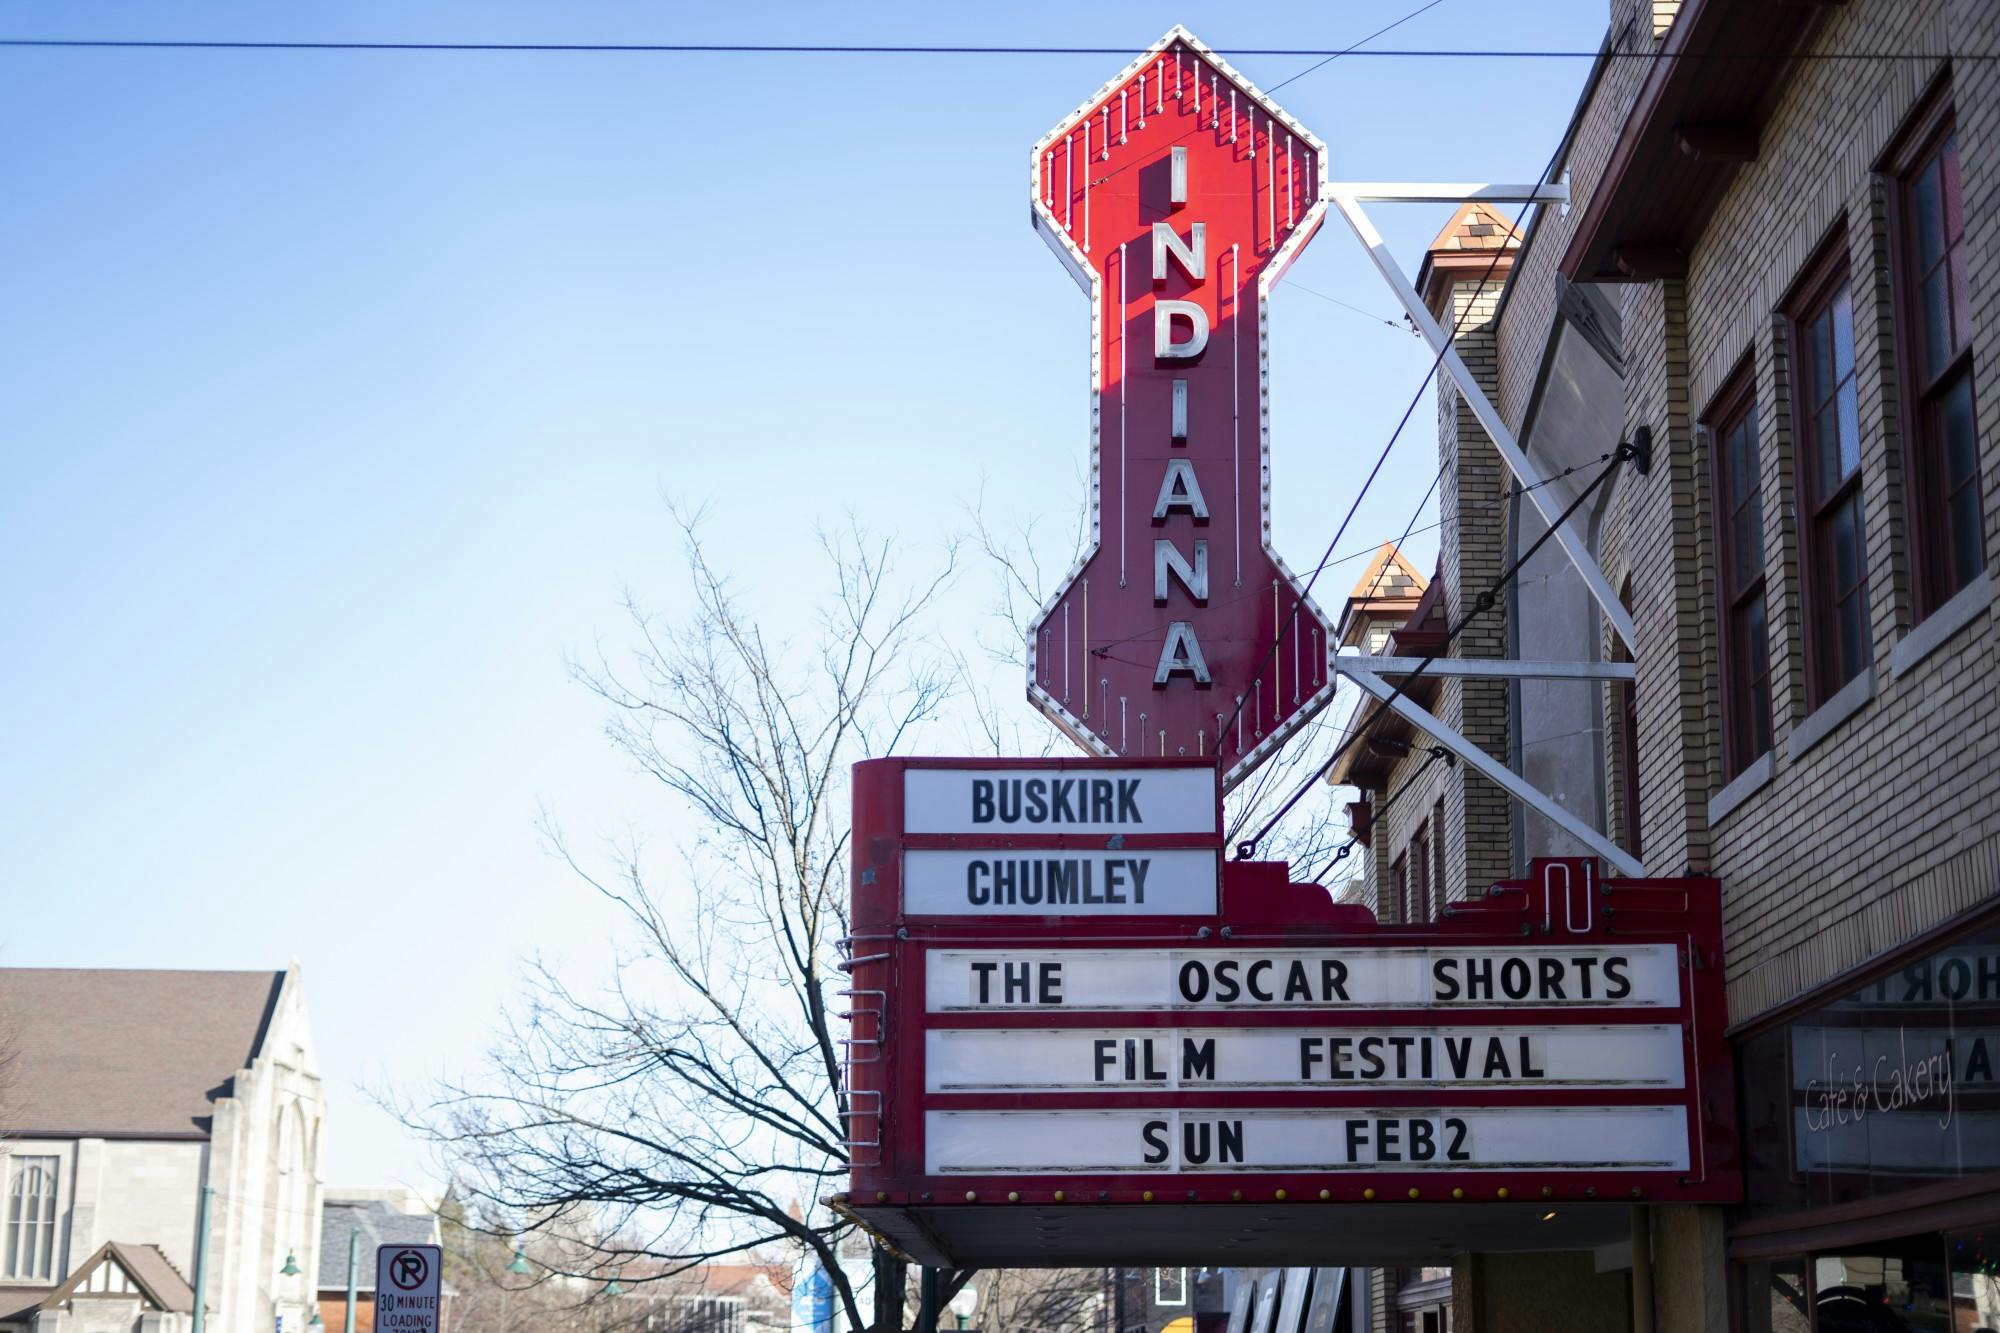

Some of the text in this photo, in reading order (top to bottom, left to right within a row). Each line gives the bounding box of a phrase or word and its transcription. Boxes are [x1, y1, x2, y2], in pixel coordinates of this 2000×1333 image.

[1152, 146, 1212, 688] INDIANA
[972, 778, 1143, 824] BUSKIRK
[967, 858, 1151, 906] CHUMLEY
[971, 957, 1631, 1004] THE OSCAR SHORTS
[1094, 1036, 1544, 1082] FILM FESTIVAL
[1804, 1024, 1953, 1132] Café & Cakery
[1142, 1120, 1244, 1165] SUN
[380, 1294, 436, 1312] 30 MINUTE
[383, 1314, 432, 1328] LOADING
